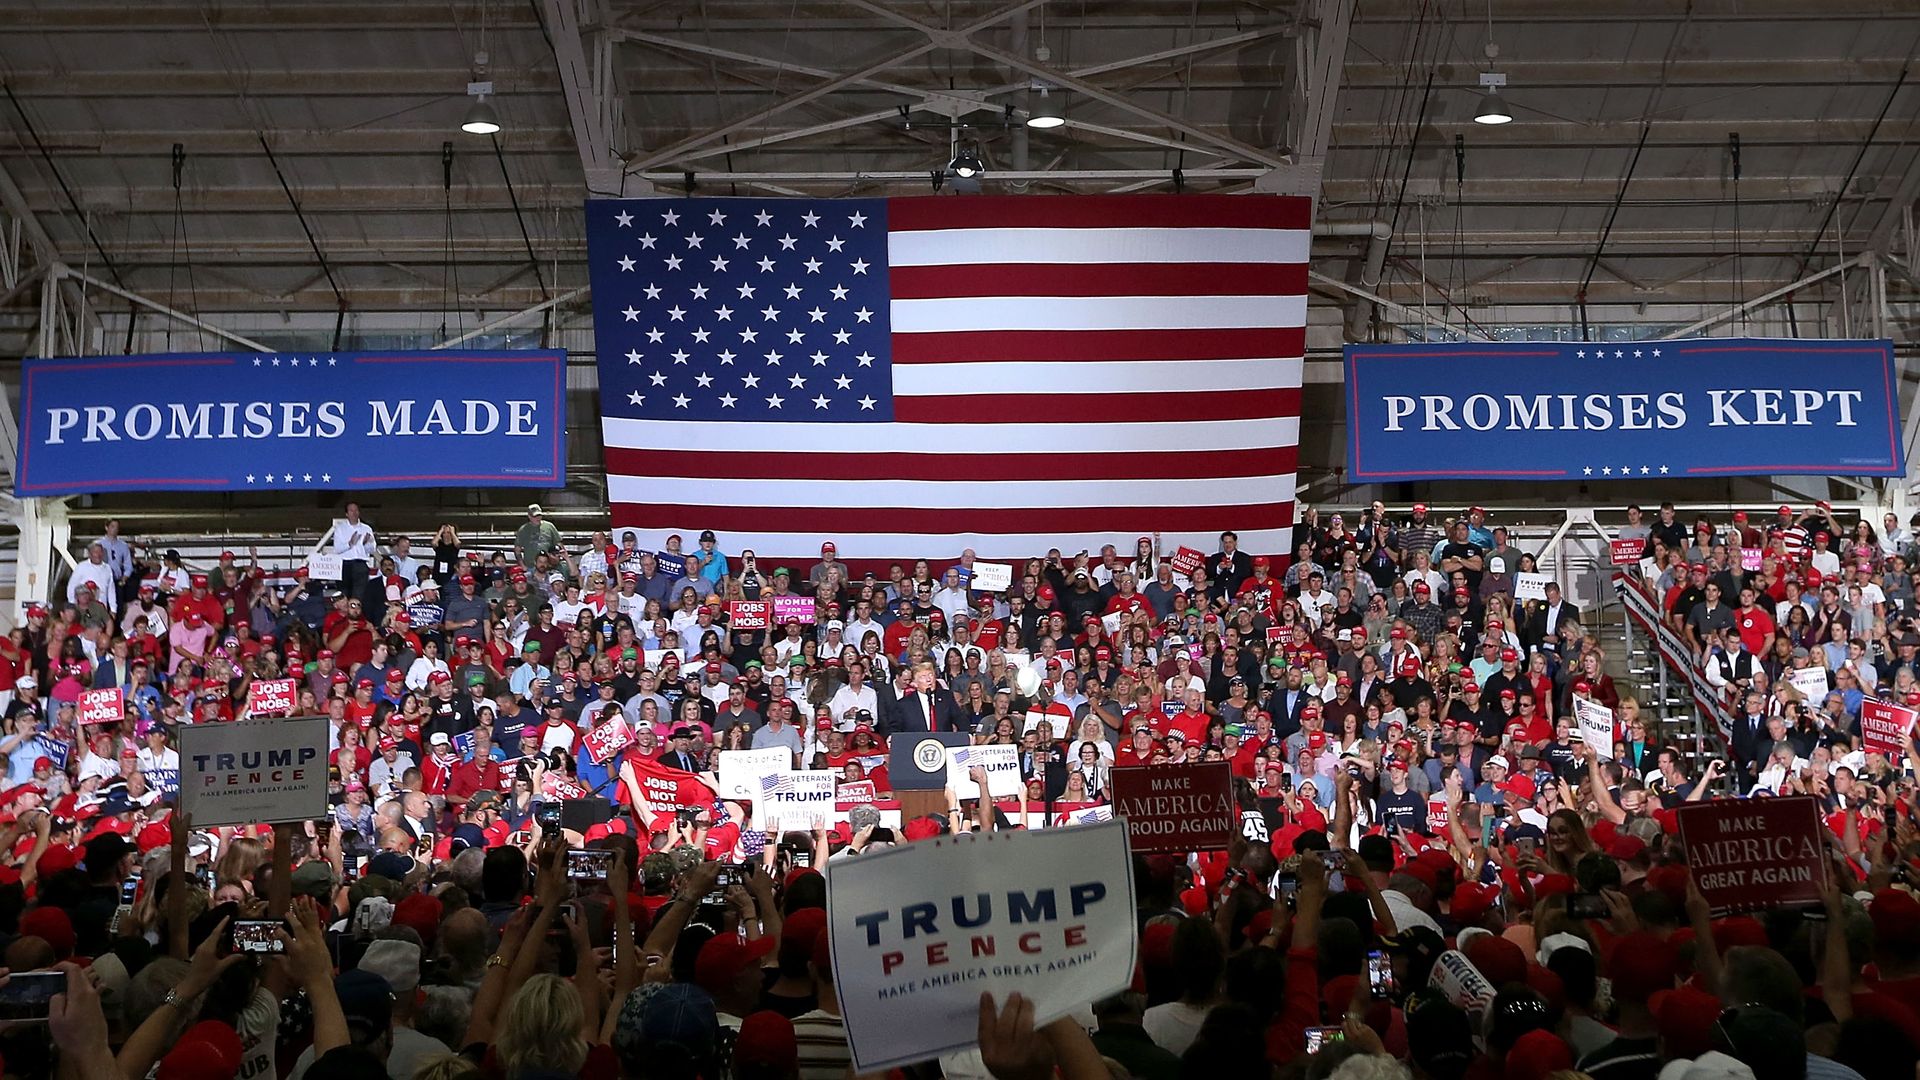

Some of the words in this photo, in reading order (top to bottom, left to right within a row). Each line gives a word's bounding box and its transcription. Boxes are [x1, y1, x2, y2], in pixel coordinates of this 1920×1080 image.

[1382, 392, 1687, 432] PROMISES
[1706, 389, 1862, 427] KEPT
[45, 402, 347, 444] PROMISES
[366, 399, 539, 436] MADE
[659, 558, 682, 569] TRUMP
[735, 603, 765, 612] JOBS
[775, 598, 815, 606] WOMEN
[734, 618, 765, 627] MOBS
[256, 682, 290, 695] JOBS
[83, 690, 117, 705] JOBS
[256, 698, 291, 711] MOBS
[83, 707, 118, 721] MOBS
[1875, 710, 1892, 720] MAKE
[1581, 716, 1611, 733] TRUMP
[591, 721, 620, 745] JOBS
[595, 734, 627, 758] MOBS
[980, 748, 1016, 756] VETERANS
[192, 747, 317, 772] TRUMP
[967, 762, 1018, 772] UMP
[204, 769, 305, 787] PENCE
[643, 776, 678, 792] JOBS
[790, 775, 832, 783] VETERANS
[816, 782, 832, 790] FOR
[1151, 777, 1191, 791] MAKE
[200, 790, 220, 798] MAKE
[222, 788, 256, 797] AMERICA
[257, 786, 281, 794] GREAT
[549, 778, 580, 799] JOBS
[649, 789, 677, 802] NOT
[775, 791, 832, 802] TRUMP
[1118, 793, 1231, 817] AMERICA
[1130, 819, 1175, 835] ROUD
[1180, 817, 1229, 834] AGAIN
[1242, 817, 1269, 843] 45
[1718, 815, 1766, 833] MAKE
[1690, 834, 1819, 869] AMERICA
[1700, 870, 1746, 890] GREAT
[1751, 865, 1812, 885] AGAIN
[855, 881, 1107, 946] TRUMP
[882, 925, 1088, 976] PENCE
[878, 981, 916, 1000] MAKE
[921, 967, 987, 991] AMERICA
[993, 963, 1040, 977] GREAT
[1047, 951, 1097, 971] AGAIN!
